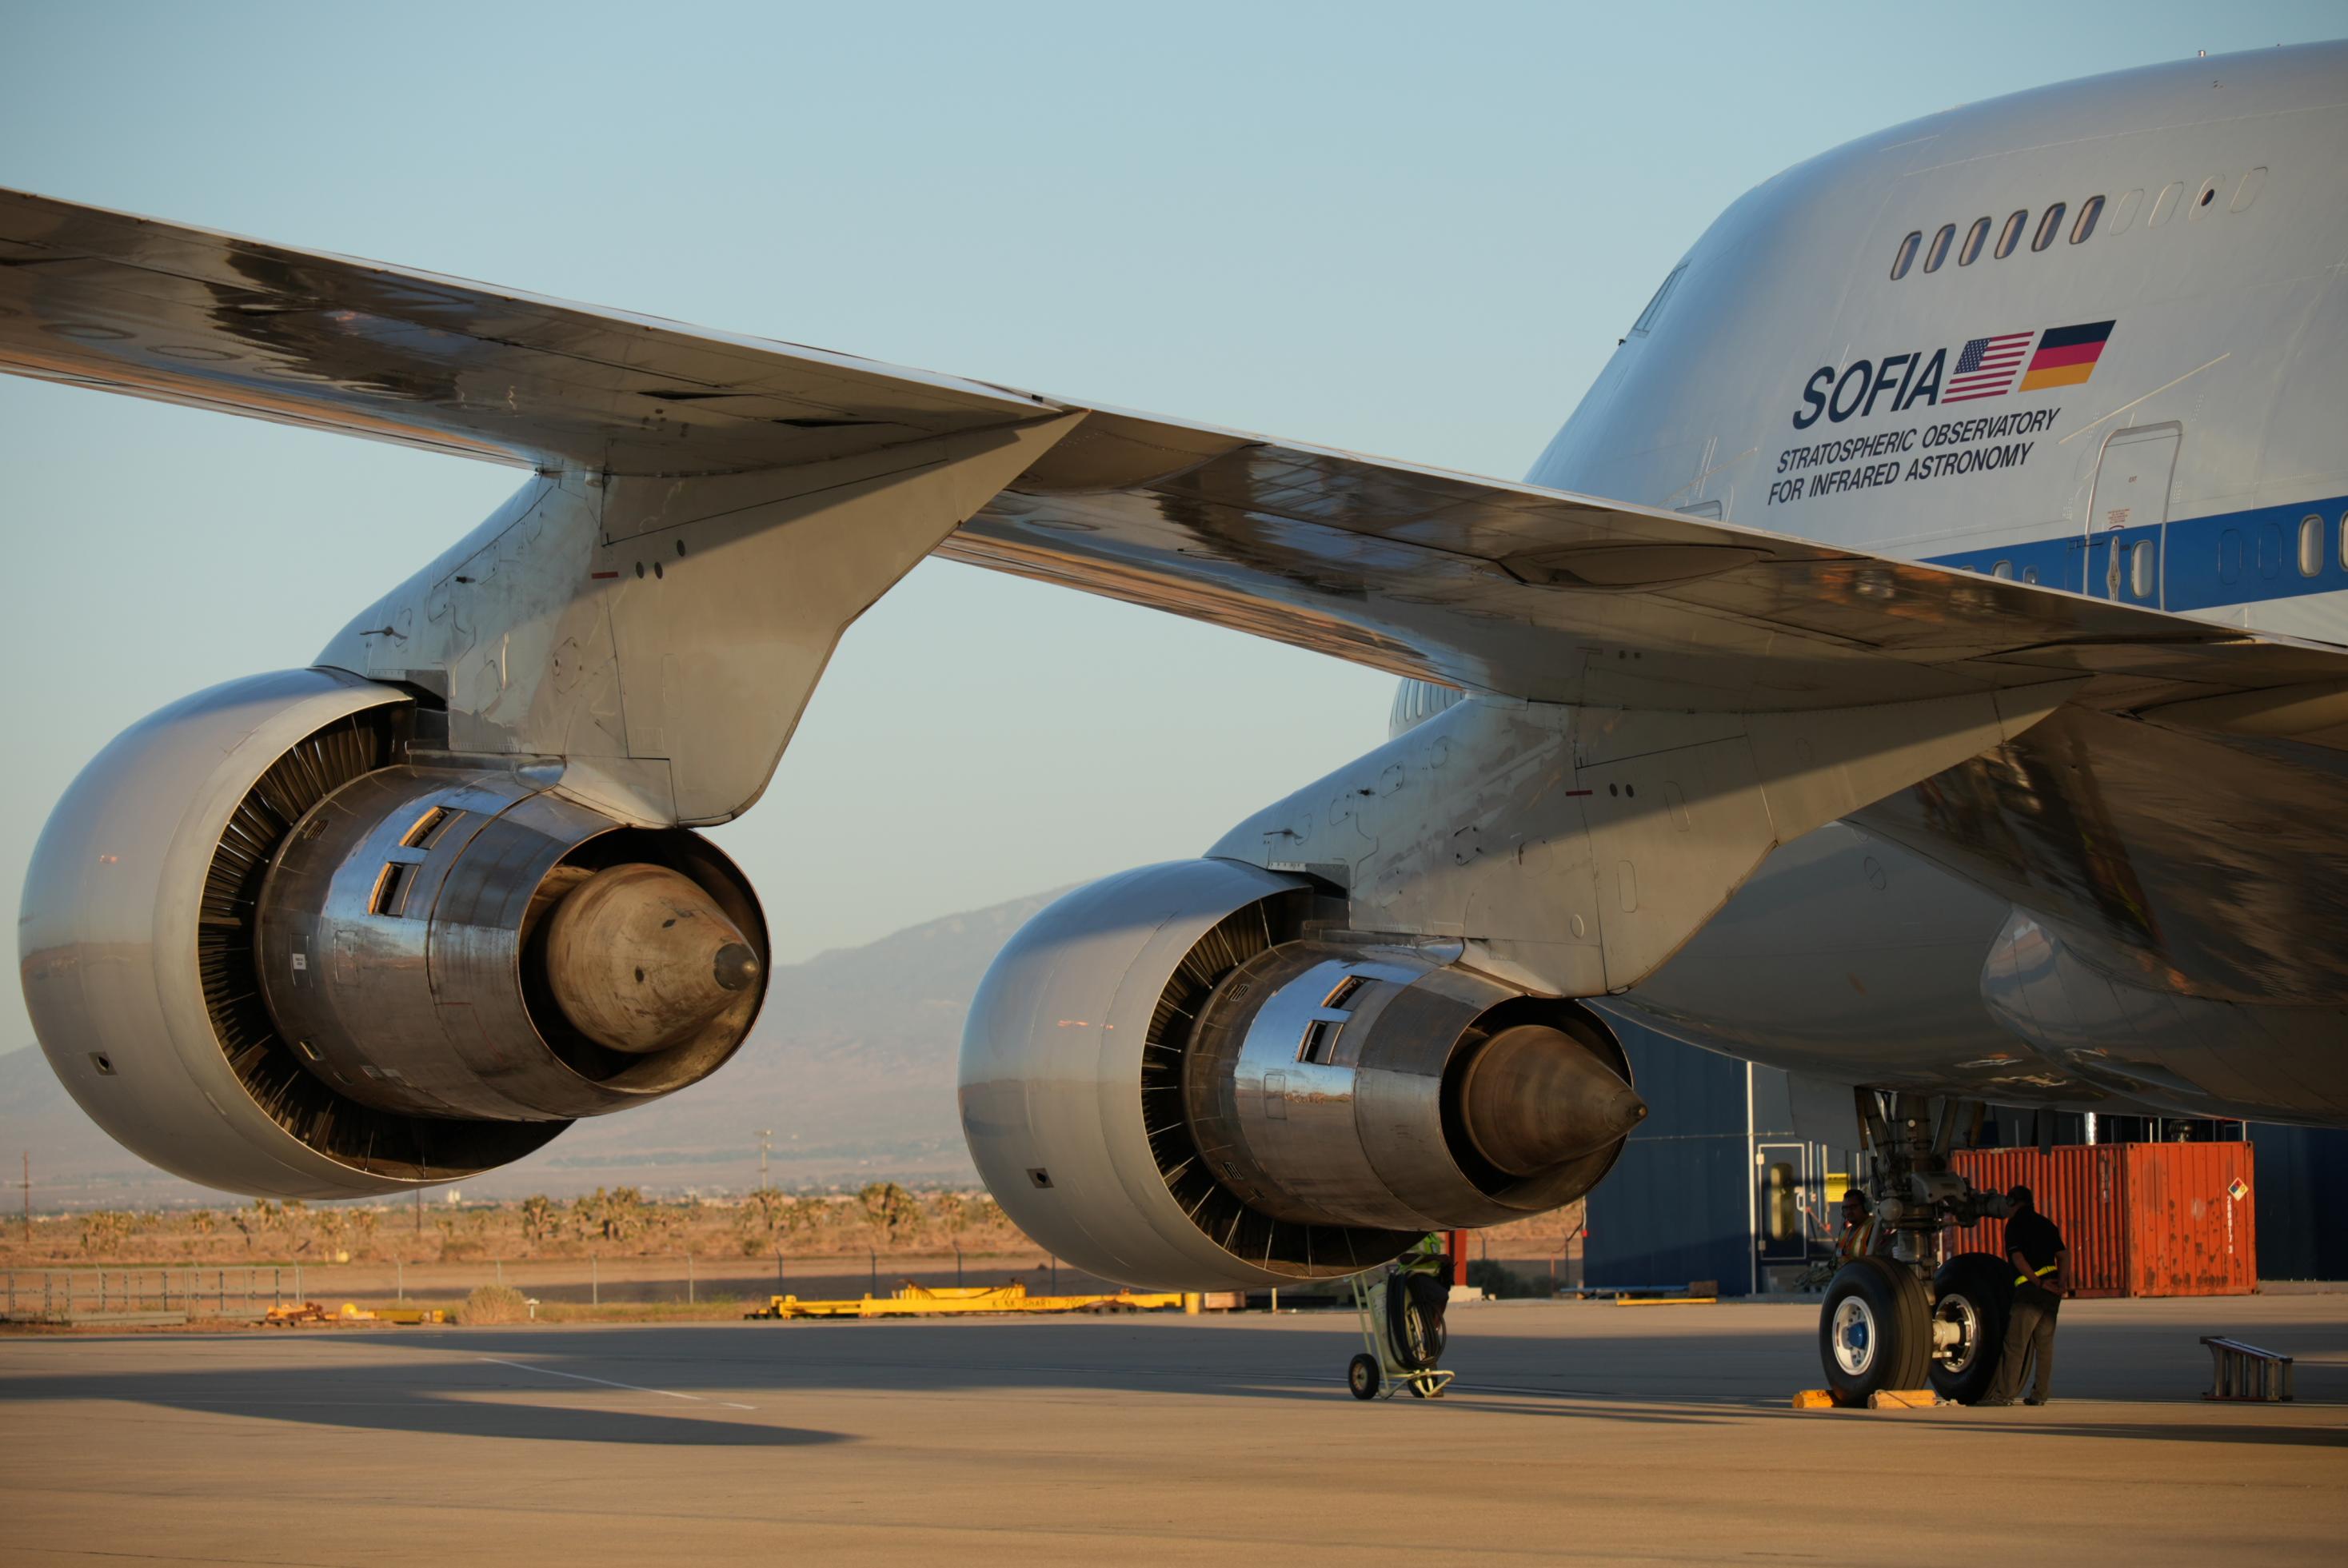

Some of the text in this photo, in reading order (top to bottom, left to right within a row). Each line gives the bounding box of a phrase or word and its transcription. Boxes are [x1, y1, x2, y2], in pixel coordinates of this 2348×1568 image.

[1792, 348, 1947, 429] SOFIA
[1767, 441, 2035, 505] FOR INFRARED ASTRONOMY
[1777, 408, 2061, 473] STRATOSPHERIC OBSERVATORY
